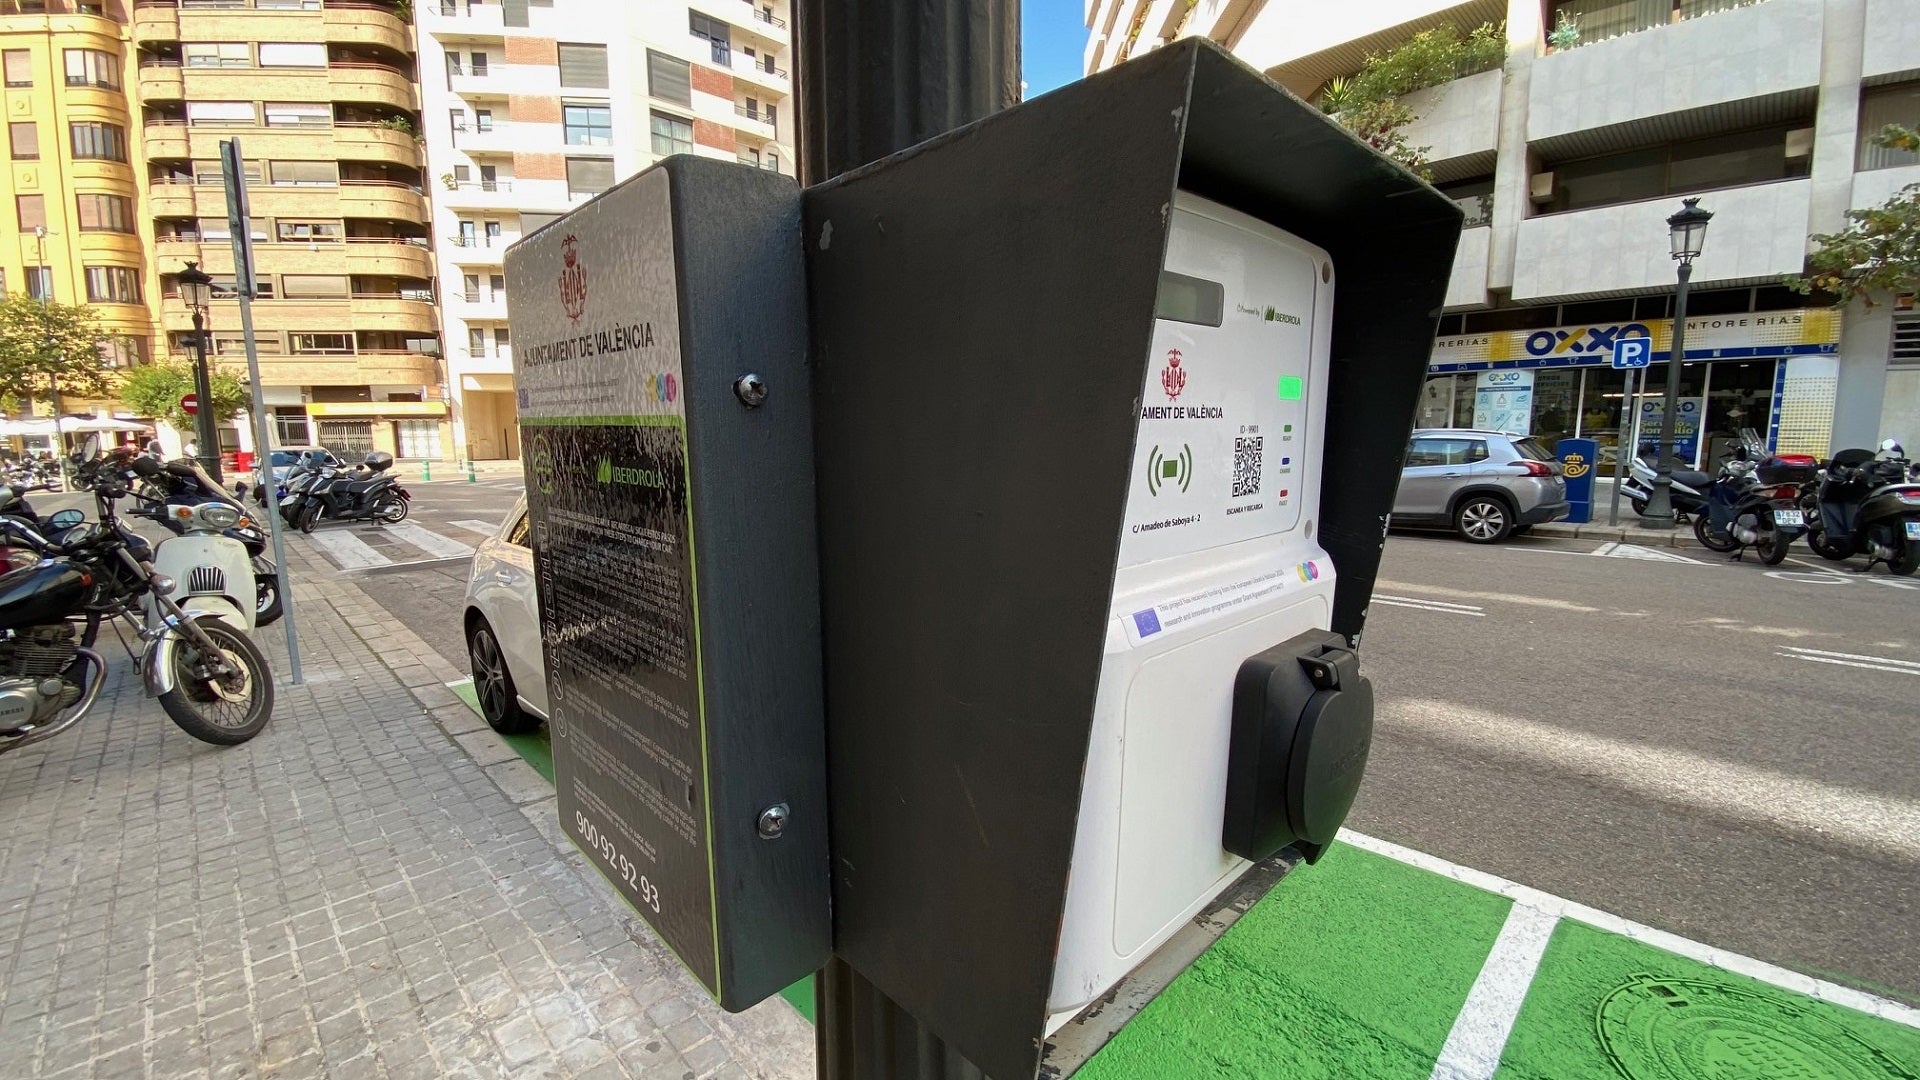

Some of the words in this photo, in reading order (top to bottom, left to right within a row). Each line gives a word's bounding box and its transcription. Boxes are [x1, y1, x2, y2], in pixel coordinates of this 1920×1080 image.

[1274, 312, 1300, 326] IBERDROLA
[524, 337, 578, 368] AJUNTAMENT
[579, 334, 593, 358] DE
[596, 322, 654, 354] VALÈNCIA
[1438, 338, 1488, 348] RERIAS
[1621, 343, 1642, 364] P
[1174, 406, 1184, 419] DE
[1187, 404, 1223, 419] VALÈNCIA
[612, 466, 665, 488] IBERDROLA
[1226, 507, 1243, 515] ESCANEA
[1132, 524, 1140, 533] C/
[1141, 521, 1163, 532] Amadeo
[1164, 519, 1171, 528] de
[1172, 516, 1190, 527] Saboya
[576, 810, 598, 849] 900
[601, 835, 617, 870] 92
[620, 854, 638, 892] 92
[640, 875, 660, 914] 93
